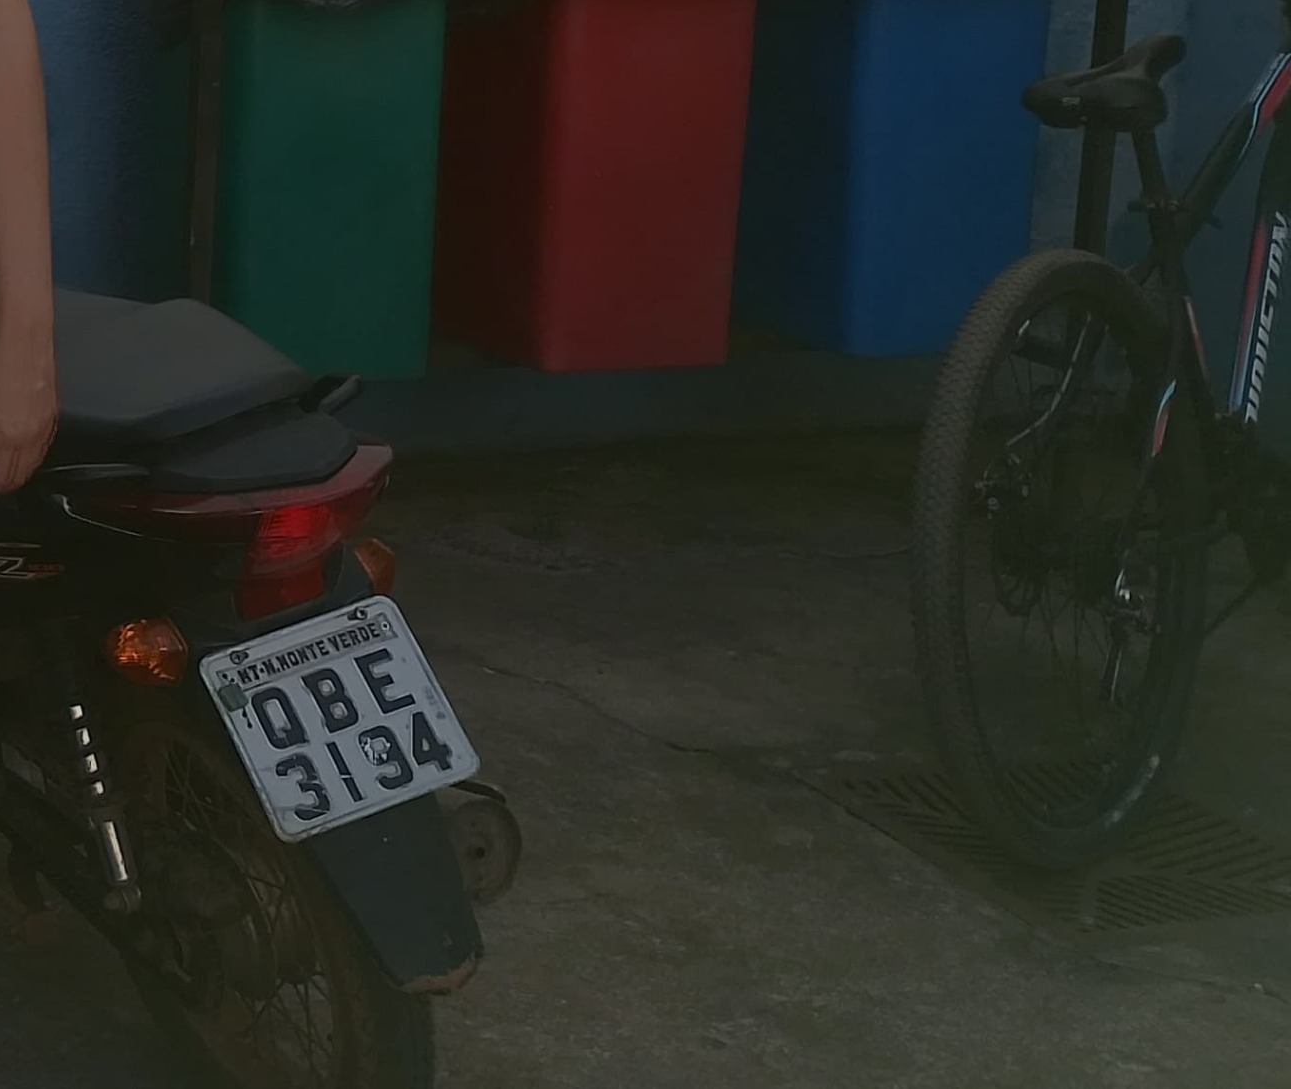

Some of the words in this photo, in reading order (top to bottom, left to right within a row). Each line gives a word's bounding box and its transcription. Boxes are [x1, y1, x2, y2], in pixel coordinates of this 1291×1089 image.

[330, 623, 380, 651] VERDE
[251, 648, 416, 749] QBE
[276, 712, 452, 820] 3194
